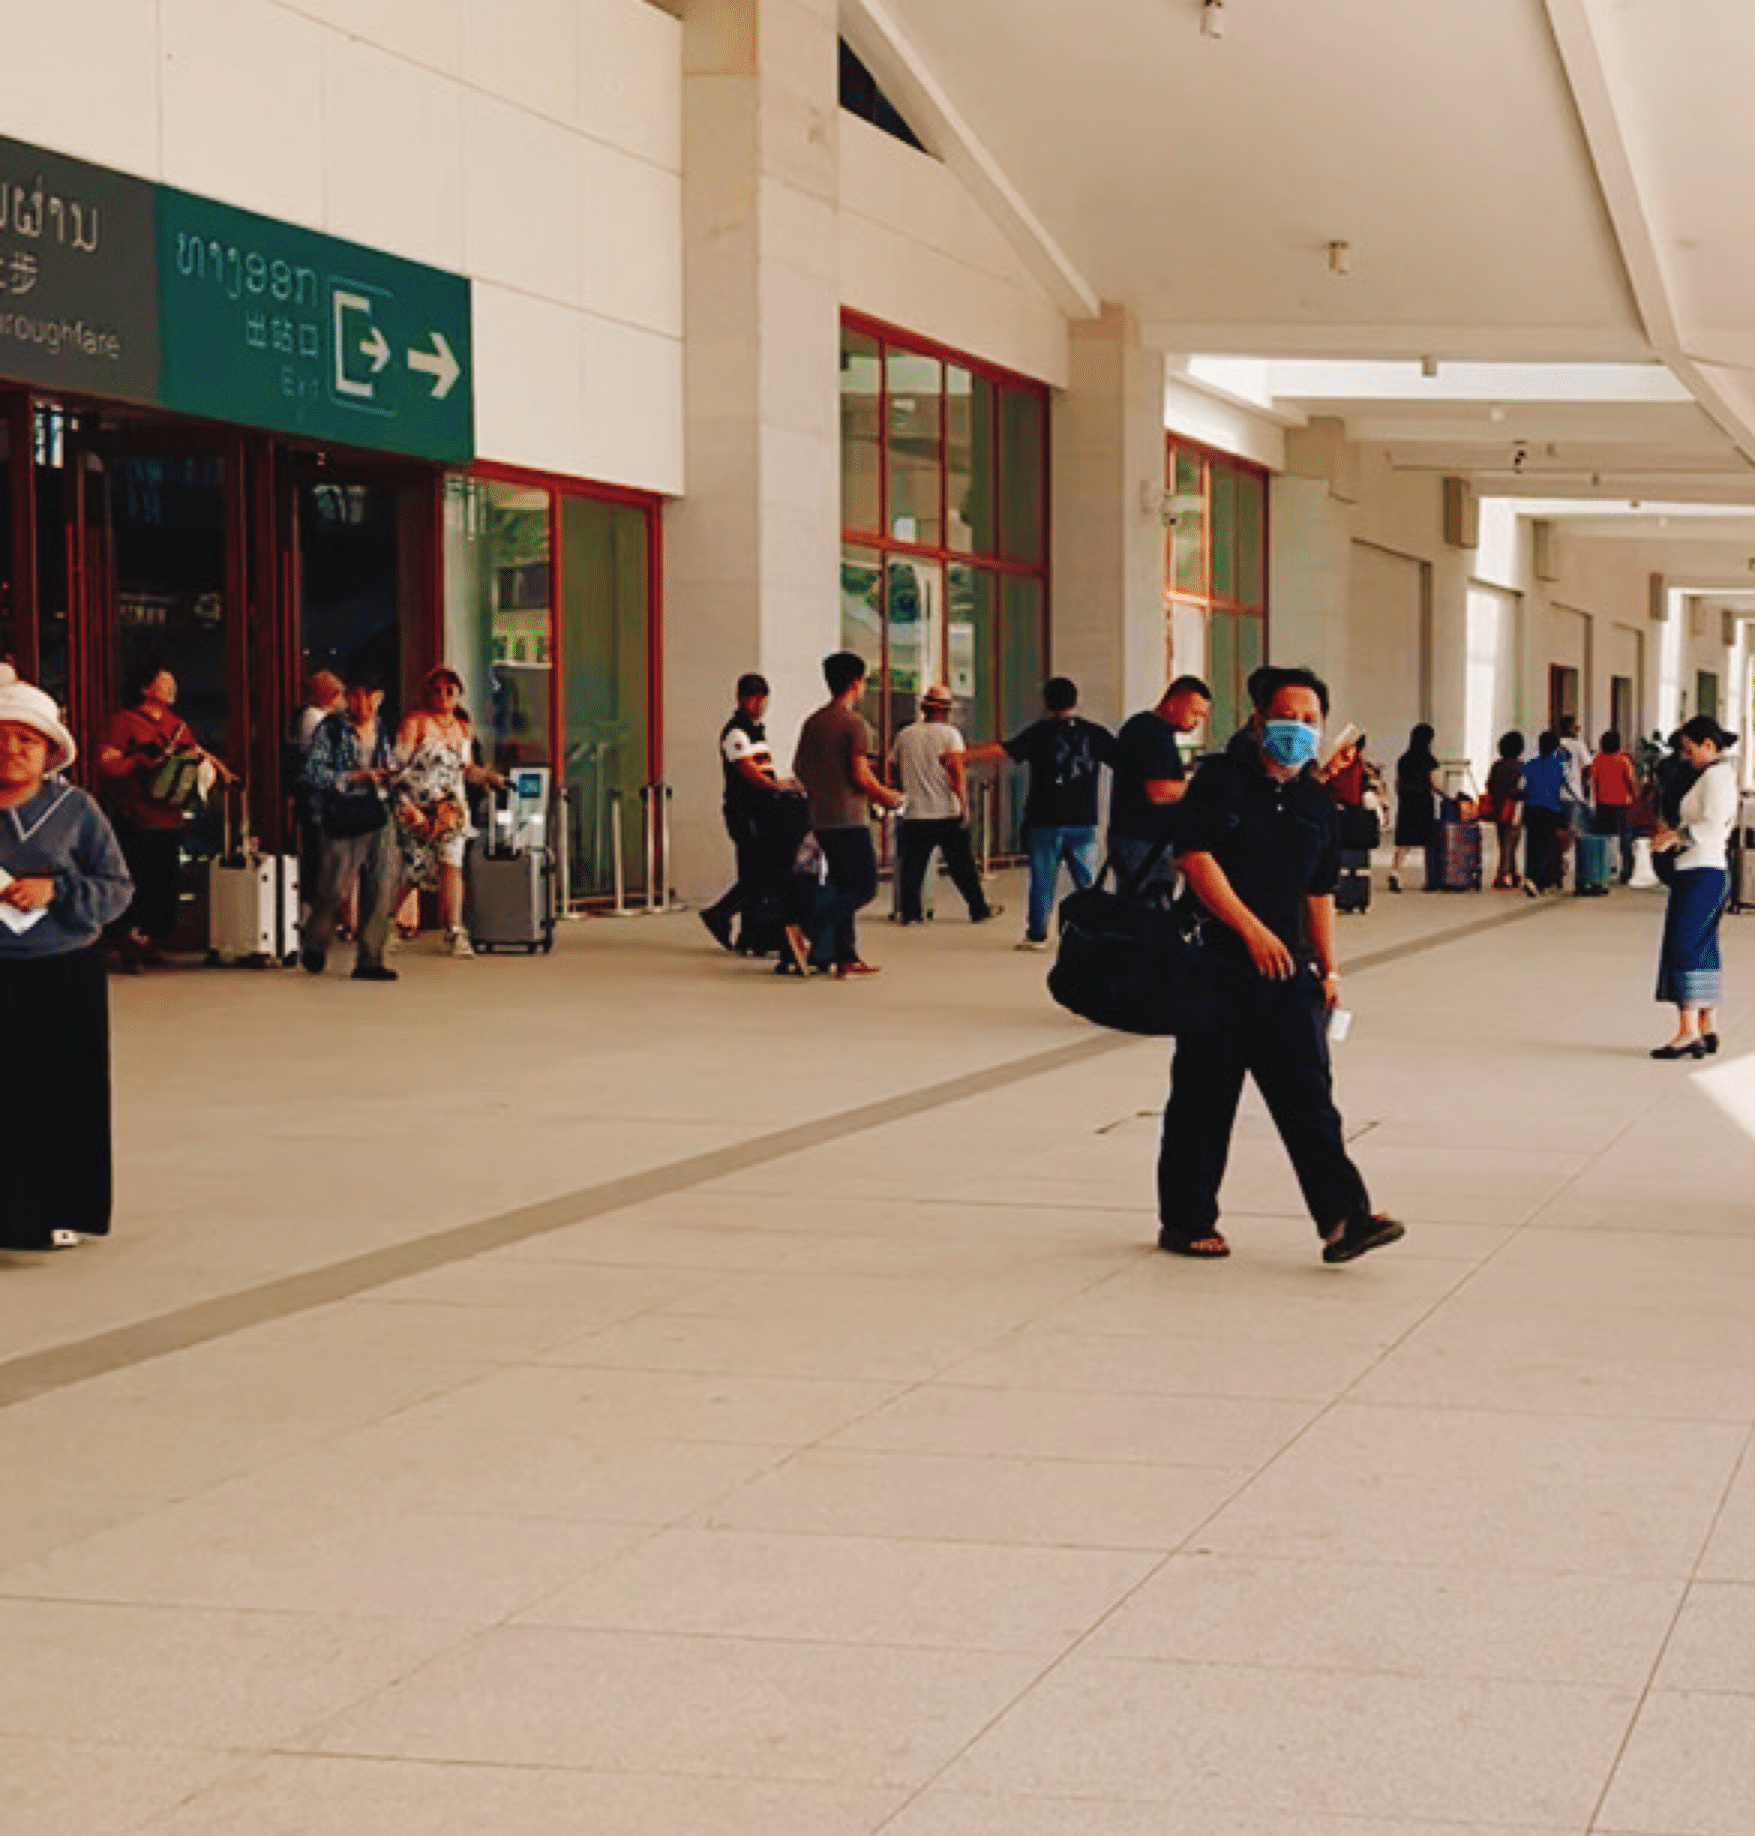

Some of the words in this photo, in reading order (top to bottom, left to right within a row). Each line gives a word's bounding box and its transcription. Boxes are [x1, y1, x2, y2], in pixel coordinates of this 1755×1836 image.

[0, 251, 39, 295] 步
[176, 231, 318, 308] ທາງອອກ
[245, 310, 318, 359] 出站口
